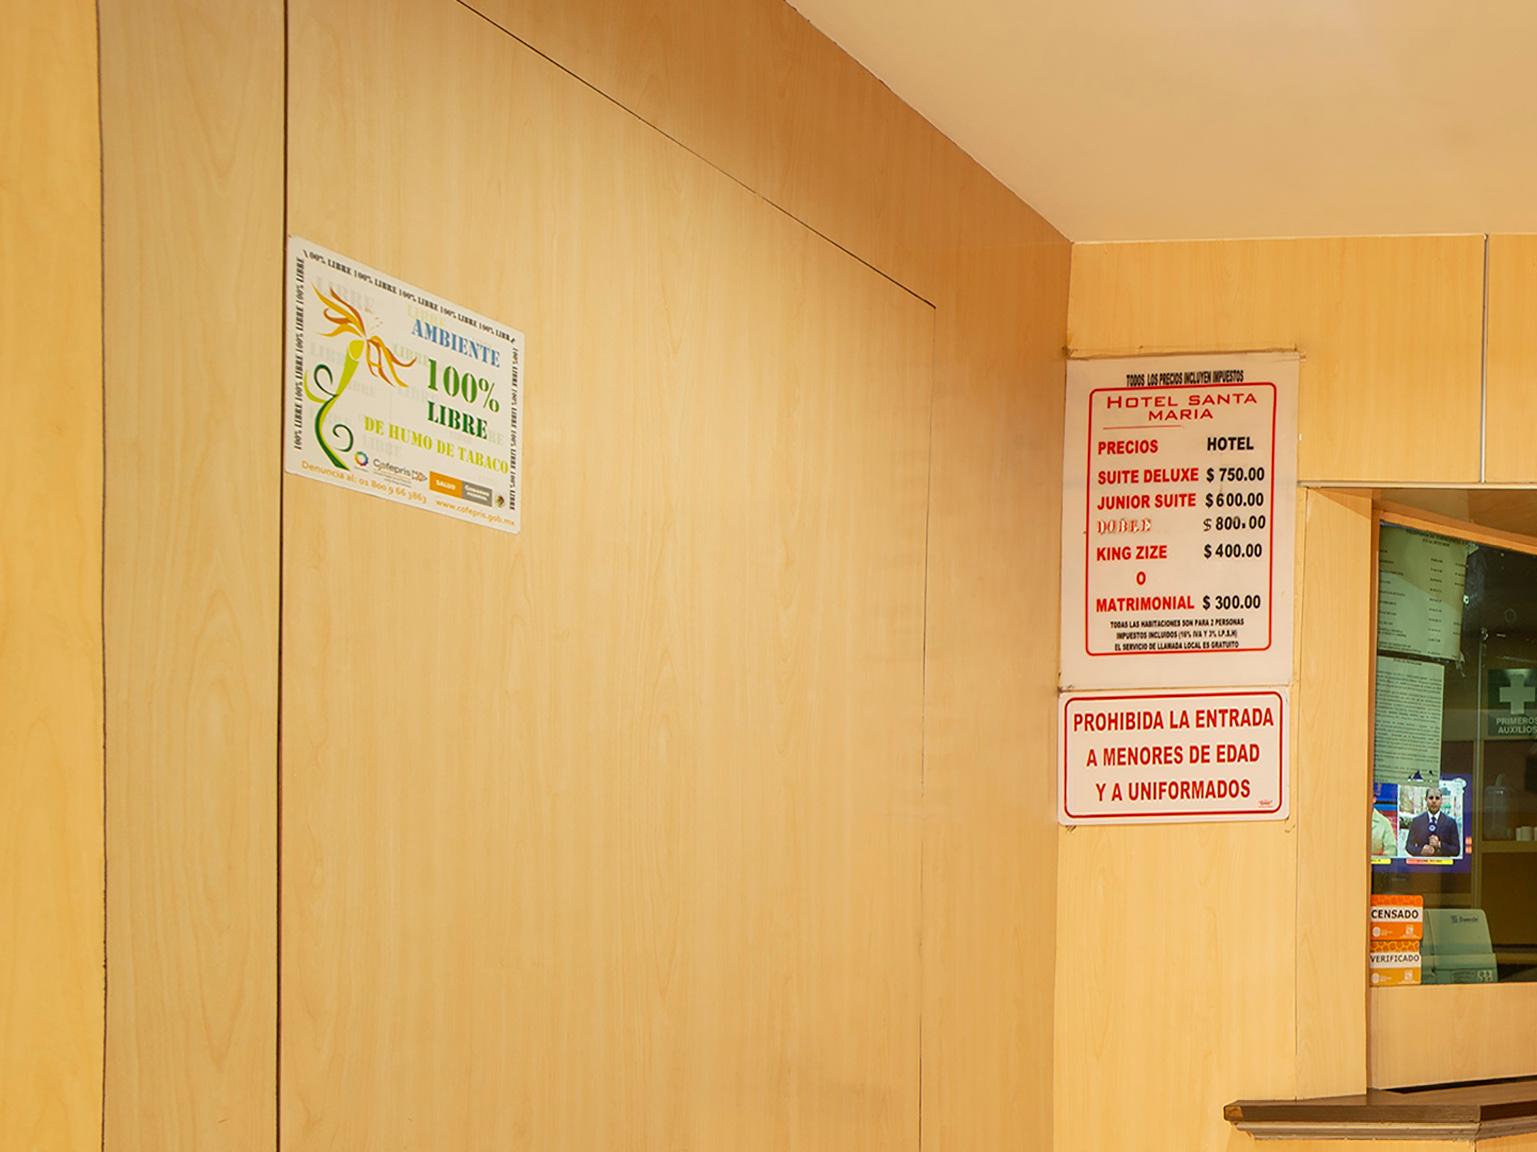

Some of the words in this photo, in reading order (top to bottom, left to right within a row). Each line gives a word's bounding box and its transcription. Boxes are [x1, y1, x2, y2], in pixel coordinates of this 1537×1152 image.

[411, 319, 500, 368] AMBIENTE
[427, 358, 500, 413] 100%
[1126, 373, 1145, 387] TODOS
[1147, 373, 1158, 386] LOS
[1159, 372, 1182, 385] PRECIOS
[1184, 371, 1211, 384] INCLUYEN
[1213, 369, 1244, 383] IMPUESTOS
[1188, 393, 1258, 406] SANTA
[427, 400, 488, 440] LIBRE
[1149, 408, 1213, 421] MARIA
[363, 415, 385, 436] DE
[388, 422, 433, 450] HUMO
[436, 439, 454, 458] DE
[458, 446, 509, 475] TABACO
[1097, 439, 1159, 456] PRECIOS
[1207, 436, 1254, 451] HOTEL
[301, 460, 345, 480] Denuncia
[1097, 469, 1140, 485] SUITE
[1143, 467, 1200, 484] DELUXE
[1096, 494, 1151, 510] JUNIOR
[1154, 493, 1197, 508] SUITE
[1096, 546, 1132, 561] KING
[1135, 545, 1168, 560] ZIZE
[1136, 571, 1147, 586] O
[1096, 595, 1195, 613] MATRIMONIAL
[1110, 621, 1128, 629] TODAS
[1129, 620, 1139, 628] LAS
[1182, 619, 1193, 627] SON
[1195, 618, 1209, 627] PARA
[1215, 617, 1244, 626] PERSONAS
[1114, 642, 1121, 651] EL
[1122, 642, 1147, 651] SERVICIO
[1149, 642, 1156, 650] DE
[1157, 641, 1183, 650] LLAMADA
[1184, 641, 1201, 649] LOCAL
[1202, 640, 1210, 649] ES
[1211, 640, 1239, 649] GRATUITO
[1073, 710, 1164, 732] PROHIBIDA
[1169, 709, 1190, 729] LA
[1195, 707, 1274, 729] ENTRADA
[1086, 748, 1098, 767] A
[1103, 745, 1184, 766] MENORES
[1189, 744, 1210, 764] DE
[1216, 743, 1260, 763] EDAD
[1095, 783, 1106, 801] Y
[1111, 782, 1123, 801] A
[1128, 779, 1251, 801] UNIFORMADOS
[1370, 909, 1419, 920] CENSADO
[1370, 954, 1420, 963] VERIFICADO
